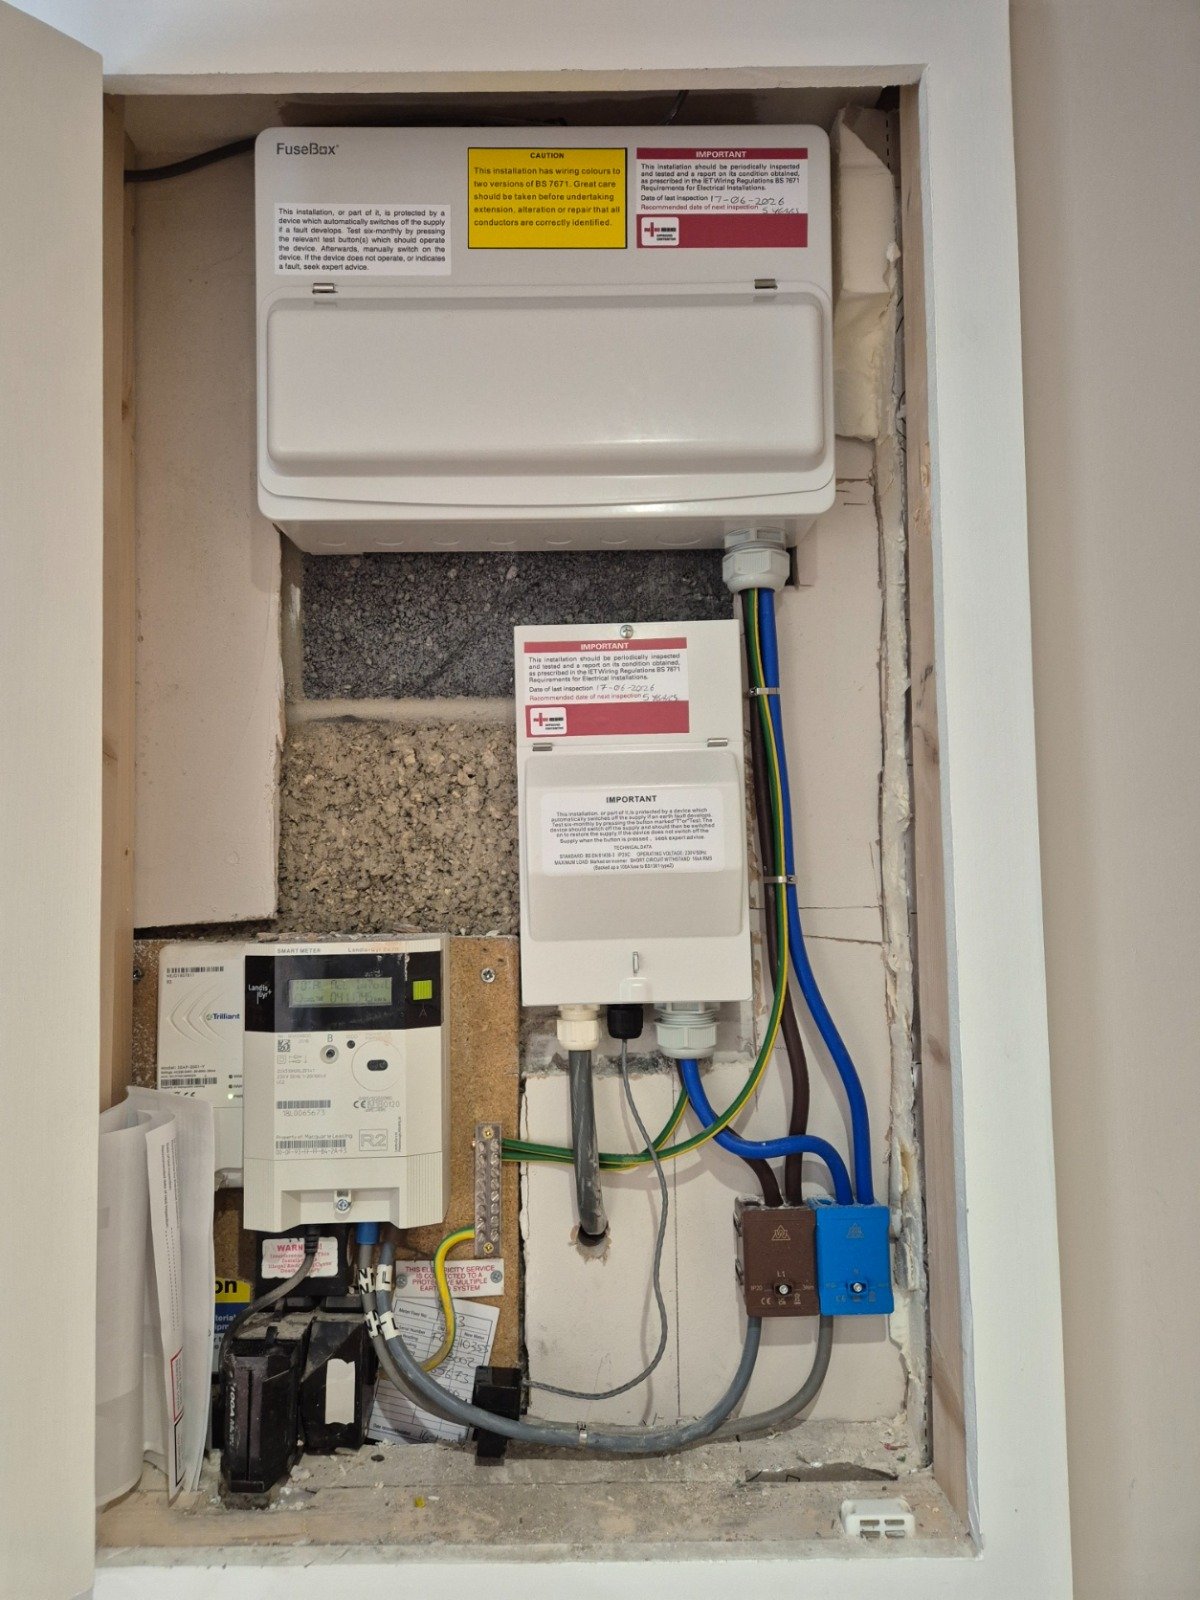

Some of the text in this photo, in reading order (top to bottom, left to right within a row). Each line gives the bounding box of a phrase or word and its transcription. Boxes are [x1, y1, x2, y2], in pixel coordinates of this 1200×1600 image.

[555, 168, 579, 176] wiring
[566, 194, 614, 202] undertaking
[348, 209, 362, 217] part
[324, 218, 368, 226] automatically
[424, 219, 445, 227] supply
[535, 219, 571, 227] correctly
[606, 795, 657, 803] IMPORTANT
[213, 1012, 240, 1020] Trilliant
[327, 1034, 333, 1042] B
[360, 1134, 387, 1147] R2
